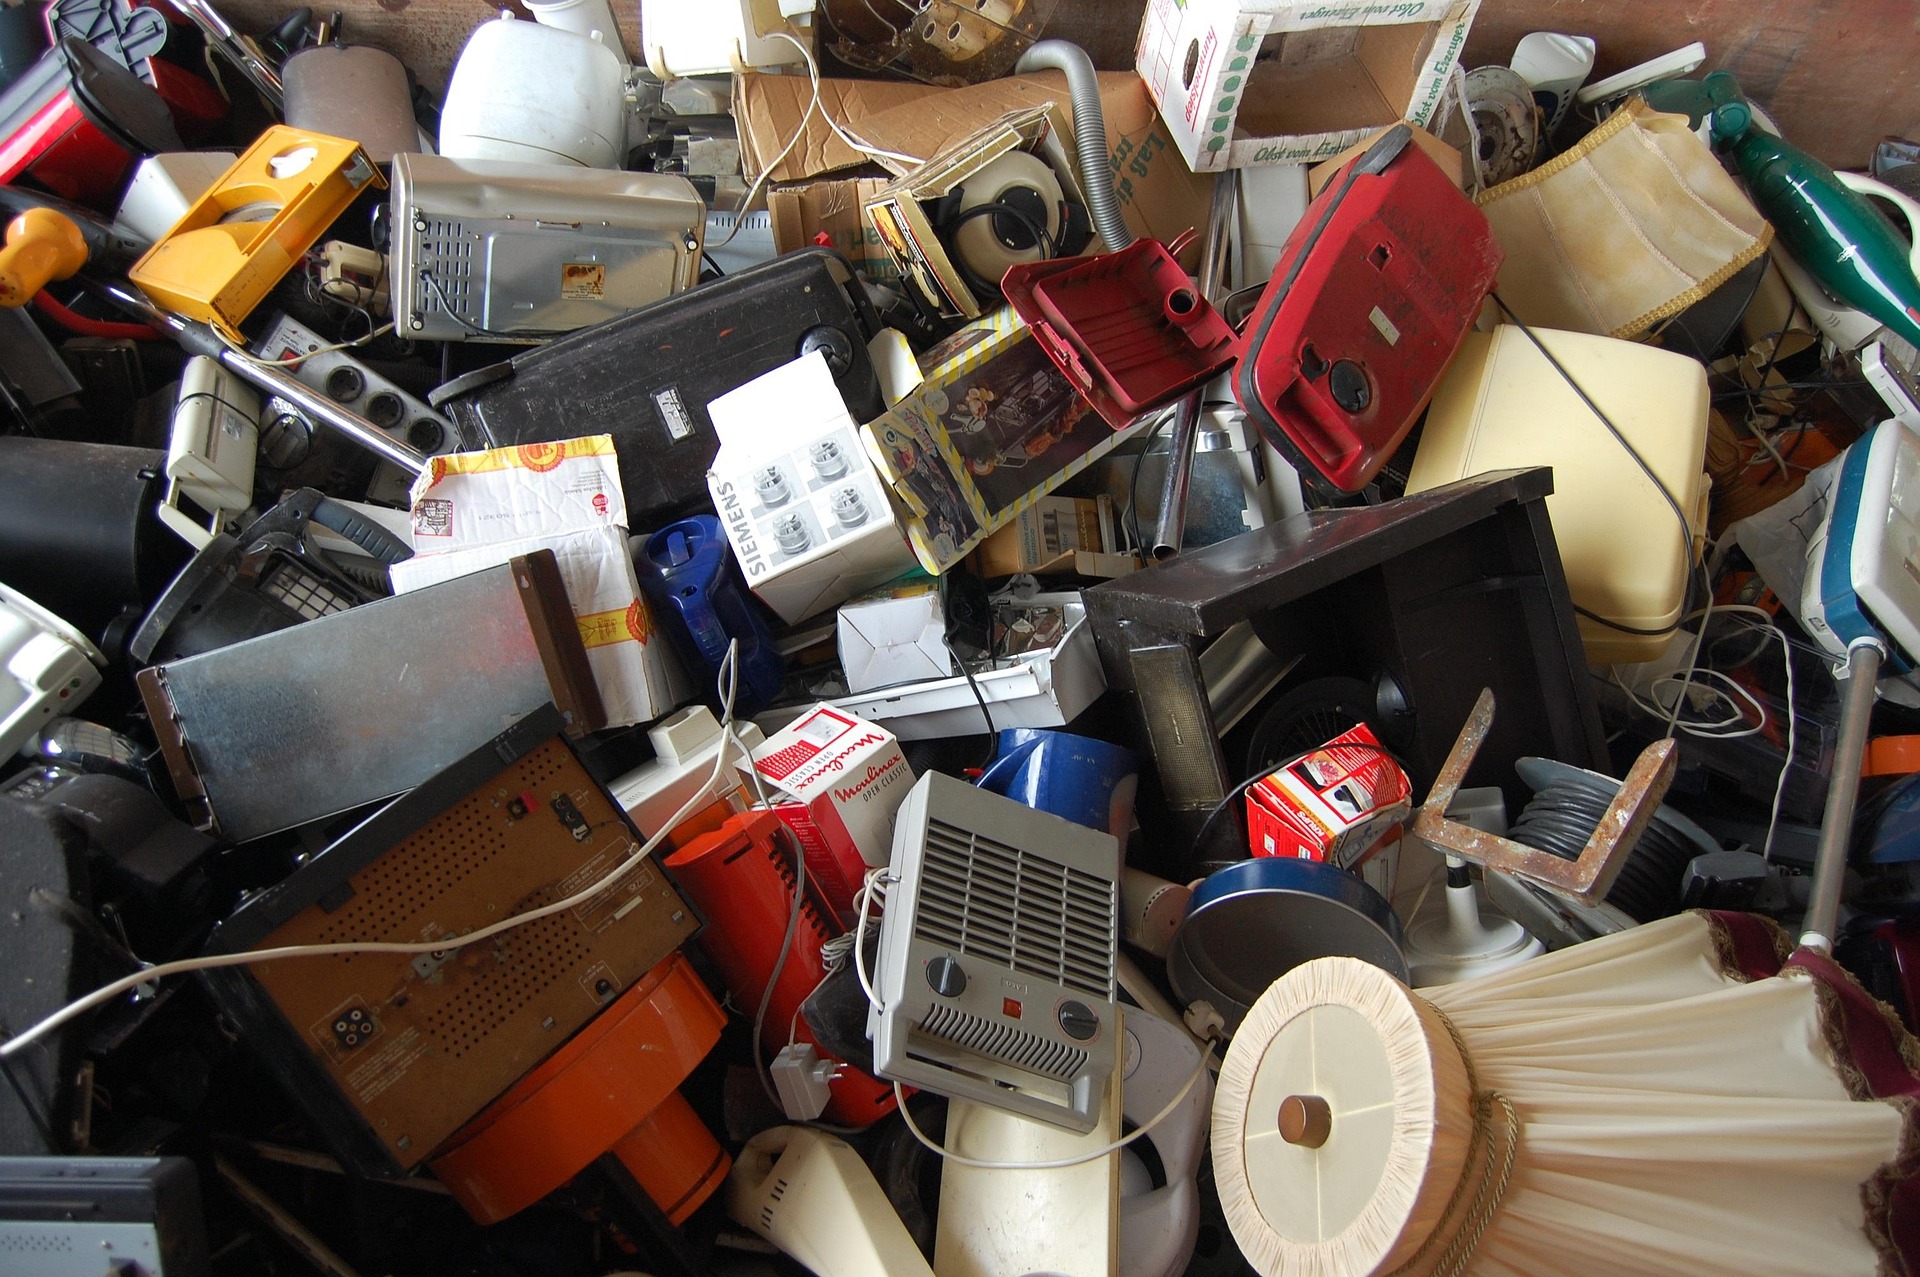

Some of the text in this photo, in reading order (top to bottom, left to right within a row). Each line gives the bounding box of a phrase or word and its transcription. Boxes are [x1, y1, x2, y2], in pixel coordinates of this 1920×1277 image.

[1300, 2, 1425, 20] Obst vom Erzeuger
[1434, 21, 1466, 75] Erzeuger
[1428, 77, 1444, 101] vom
[1129, 132, 1167, 178] Laß
[1253, 146, 1287, 162] Obst
[1287, 147, 1311, 158] vom
[716, 481, 767, 577] SIEMENS
[794, 733, 885, 790] Moulinex
[815, 750, 835, 766] OPEN
[784, 765, 815, 789] CLASSIC
[834, 754, 902, 803] Moulinex
[862, 762, 908, 802] OPEN CLASSIC
[1297, 810, 1326, 838] KRUPS
